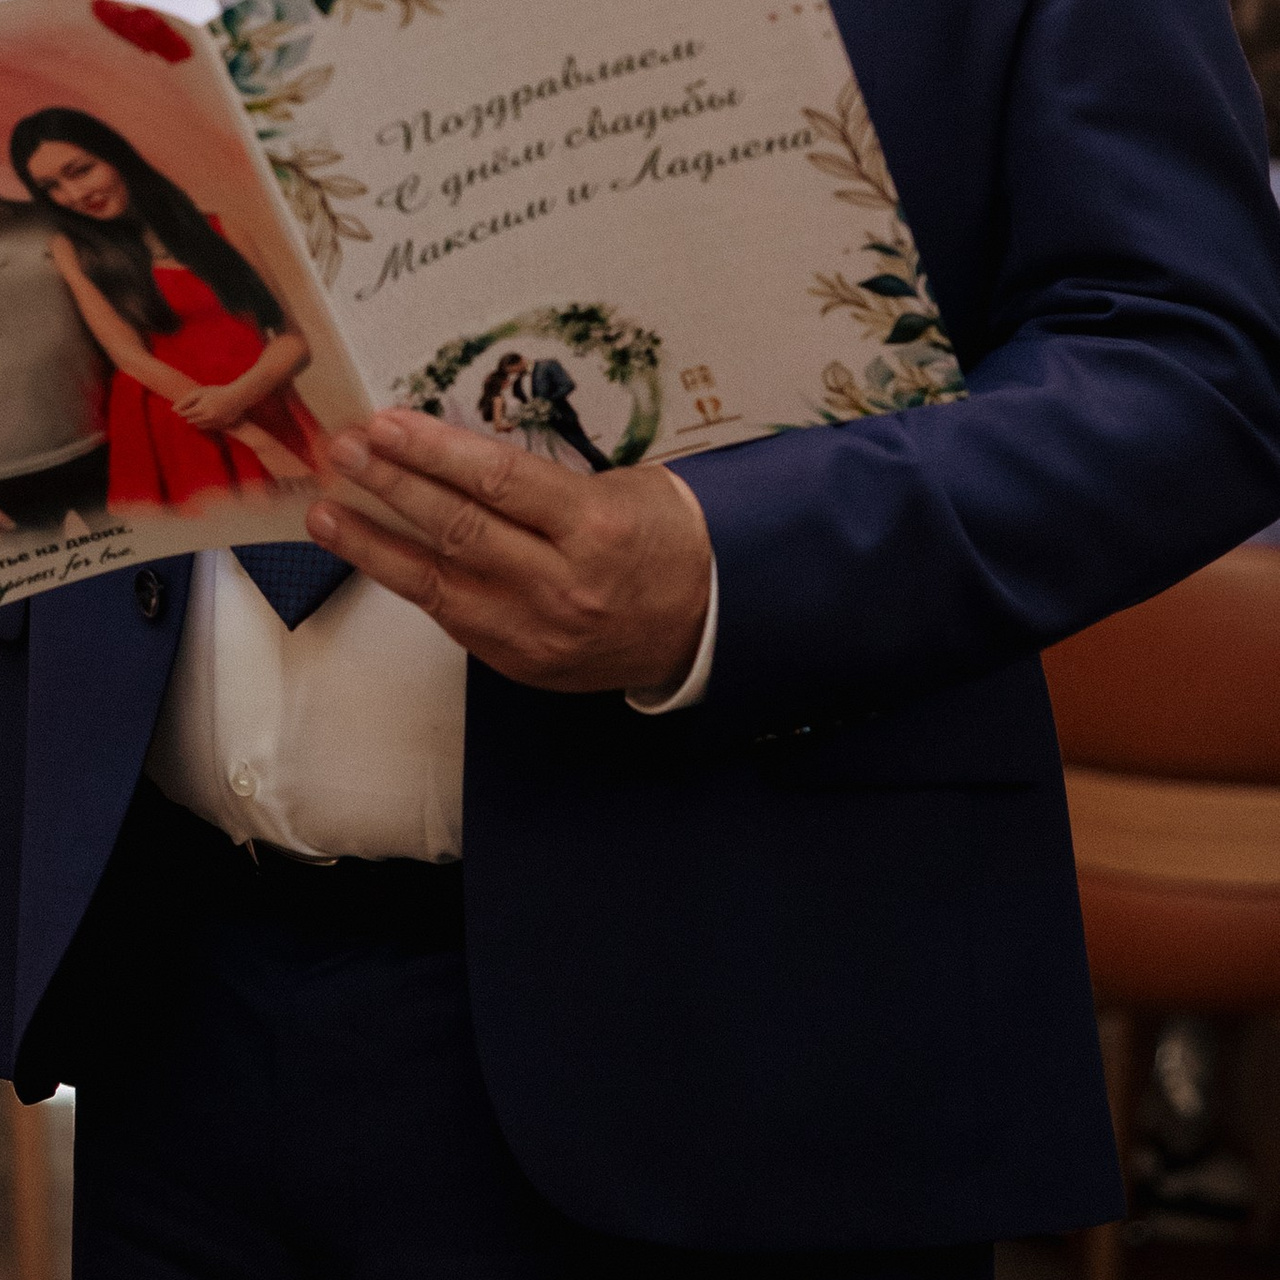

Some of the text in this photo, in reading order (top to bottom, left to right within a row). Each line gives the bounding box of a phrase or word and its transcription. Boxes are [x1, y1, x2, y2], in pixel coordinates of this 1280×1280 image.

[375, 37, 705, 154] Поздравляем
[375, 78, 745, 215] С днём свадьбы
[355, 196, 557, 301] Максим
[566, 179, 601, 207] и
[34, 543, 60, 557] на
[58, 552, 92, 580] for
